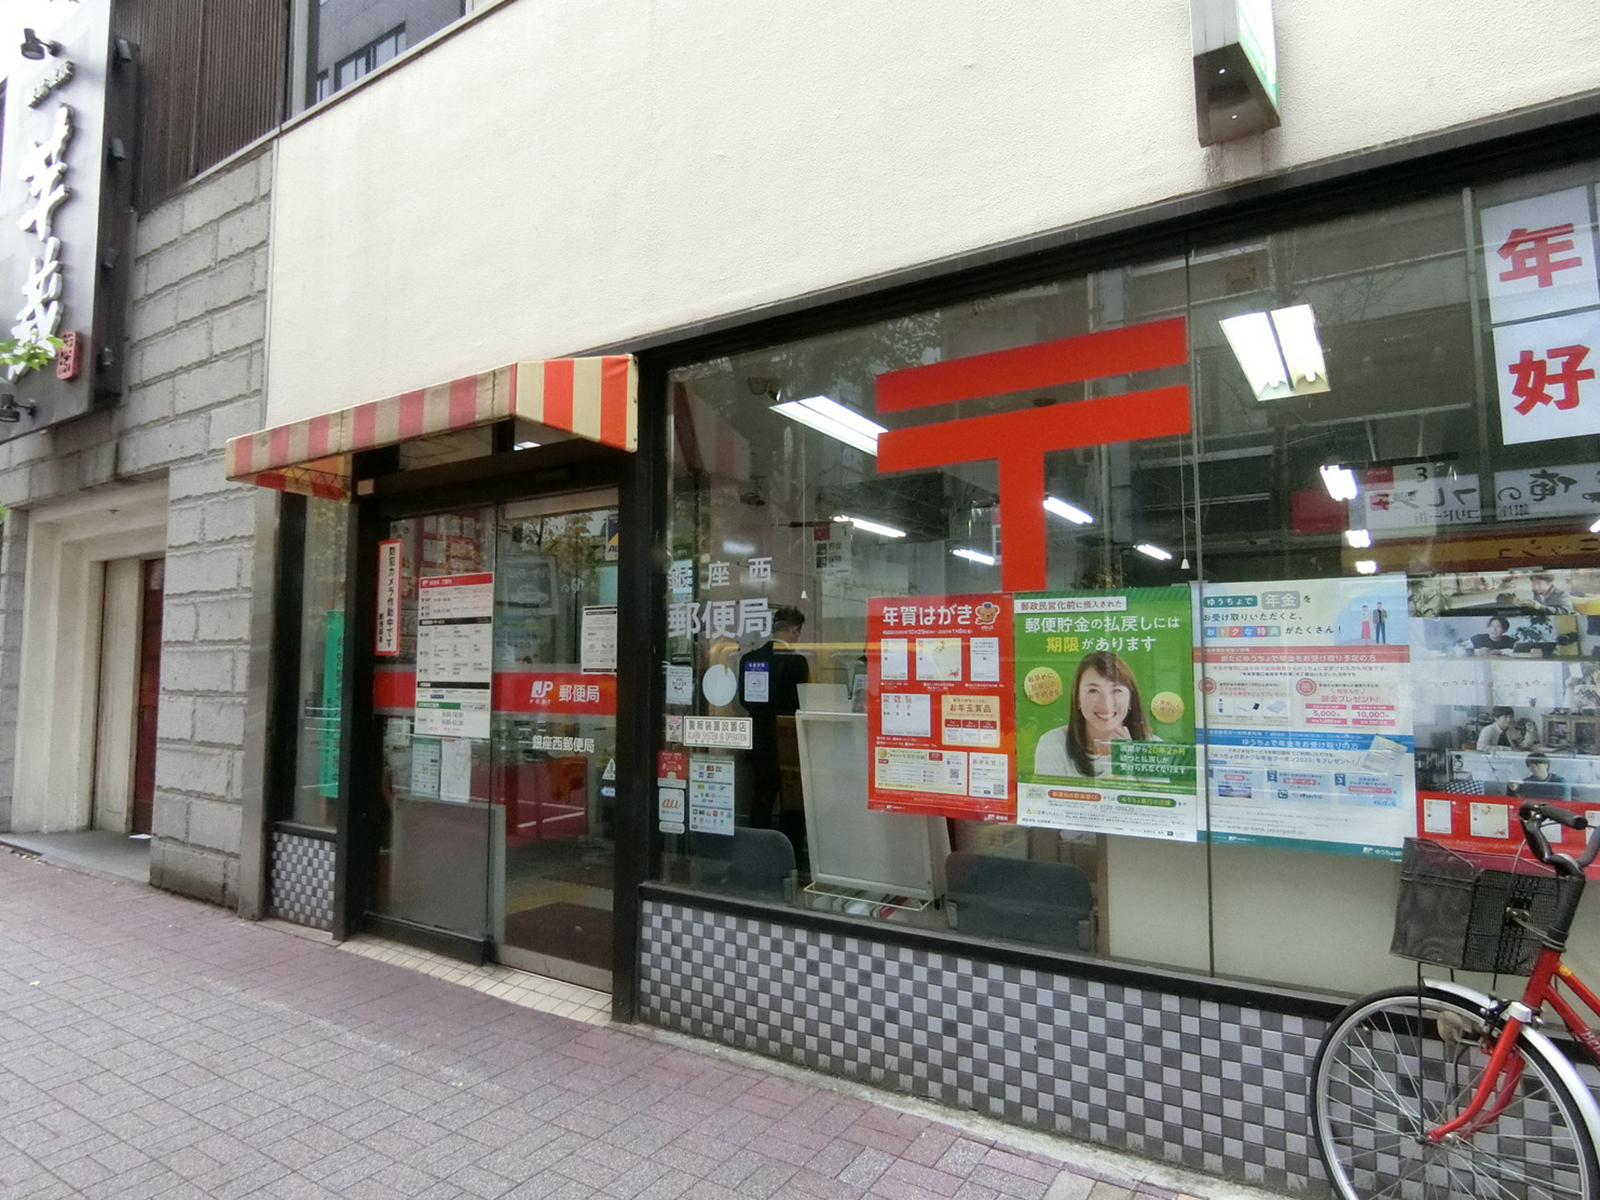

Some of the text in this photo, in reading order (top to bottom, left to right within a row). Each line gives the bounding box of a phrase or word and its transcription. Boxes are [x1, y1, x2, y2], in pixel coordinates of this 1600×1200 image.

[1497, 223, 1582, 289] 年
[1508, 344, 1596, 416] 好
[386, 546, 396, 648] 防犯カメラ作動中です
[1020, 600, 1122, 611] 郵政民営化前に預入された
[1206, 593, 1312, 608] ゆうちょで 年金 を
[668, 598, 773, 640] 郵便局
[882, 603, 973, 627] 年賀はがき
[1025, 615, 1180, 634] 郵便貯金の払戻しには
[1203, 612, 1303, 622] お受け取りいただくと、
[1285, 625, 1342, 635] がたくさん!
[1046, 636, 1156, 653] 期限があります
[559, 684, 600, 703] 郵便局
[950, 704, 992, 713] お年玉賞品
[532, 735, 595, 754] 銀座西郵便局
[663, 798, 682, 809] au
